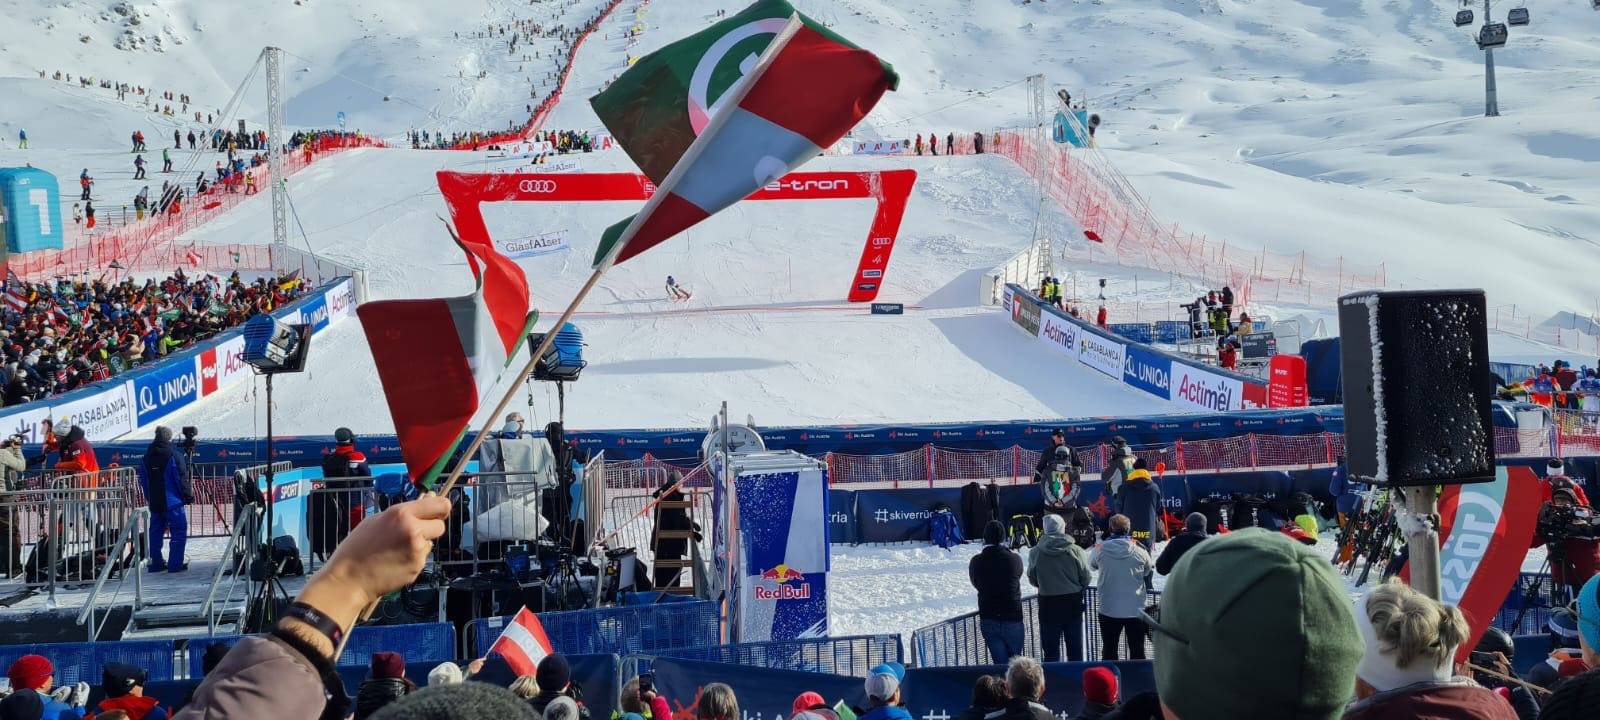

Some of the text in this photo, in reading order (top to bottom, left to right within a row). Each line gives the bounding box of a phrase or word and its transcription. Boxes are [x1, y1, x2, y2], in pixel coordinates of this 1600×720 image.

[764, 179, 848, 191] e-tron
[1043, 319, 1076, 350] Actimel
[1138, 361, 1169, 391] UNIQA
[158, 372, 196, 406] UNIQA
[1178, 373, 1232, 412] Actimel
[280, 483, 298, 500] SPORT
[874, 508, 933, 524] #skiverrü
[1132, 530, 1152, 539] SWE
[755, 583, 811, 599] Red Bull
